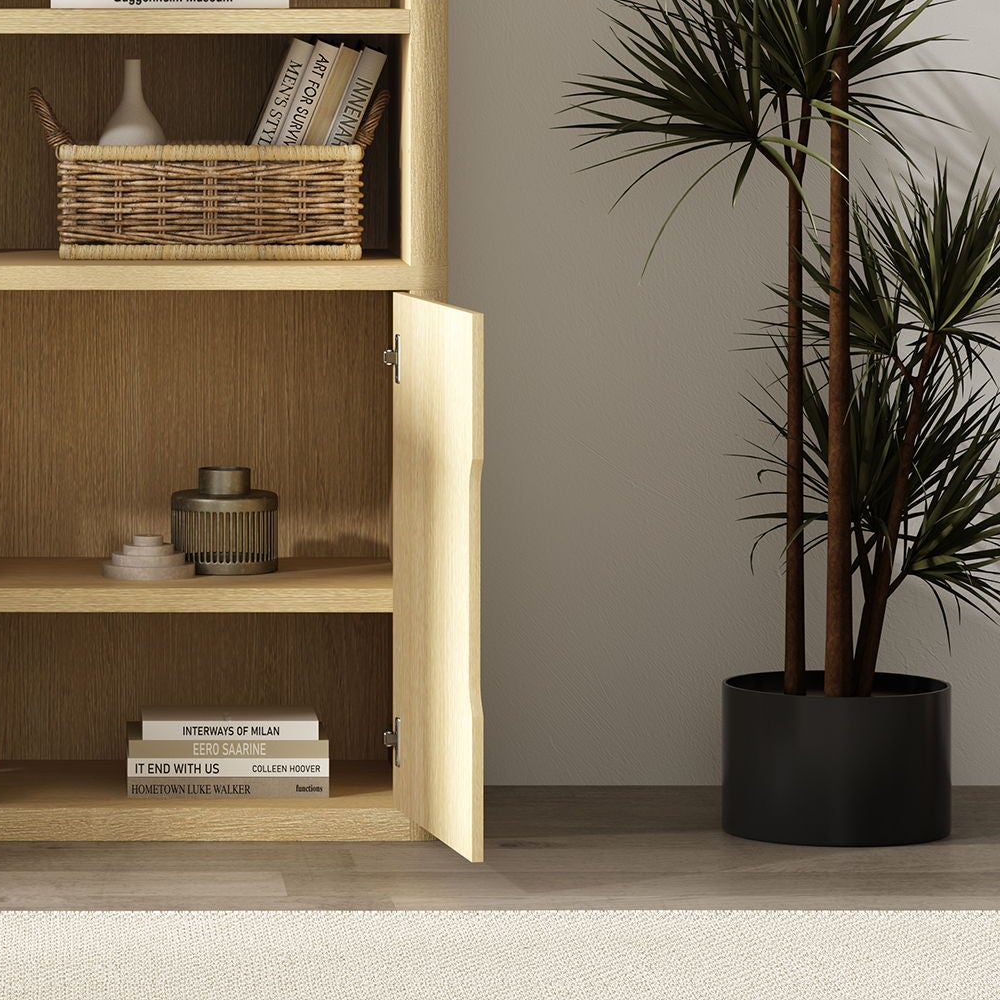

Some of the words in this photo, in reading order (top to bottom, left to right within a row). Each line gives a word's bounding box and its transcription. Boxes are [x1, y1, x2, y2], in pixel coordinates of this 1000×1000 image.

[311, 53, 330, 79] ART
[274, 60, 303, 109] MEN'S
[299, 79, 320, 105] FOR
[182, 726, 235, 736] INTERWAYS
[236, 726, 249, 736] OF
[251, 726, 280, 736] MILAN
[193, 742, 220, 756] EERO
[222, 742, 267, 756] SAARINE
[135, 763, 145, 774] IT
[147, 763, 171, 774] END
[174, 763, 201, 774] WITH
[205, 763, 220, 774] US
[252, 765, 288, 773] COLLEEN
[289, 765, 321, 773] HOOVER
[131, 784, 187, 795] HOMETOWN
[187, 784, 211, 795] LUKE
[213, 784, 251, 795] WALKER
